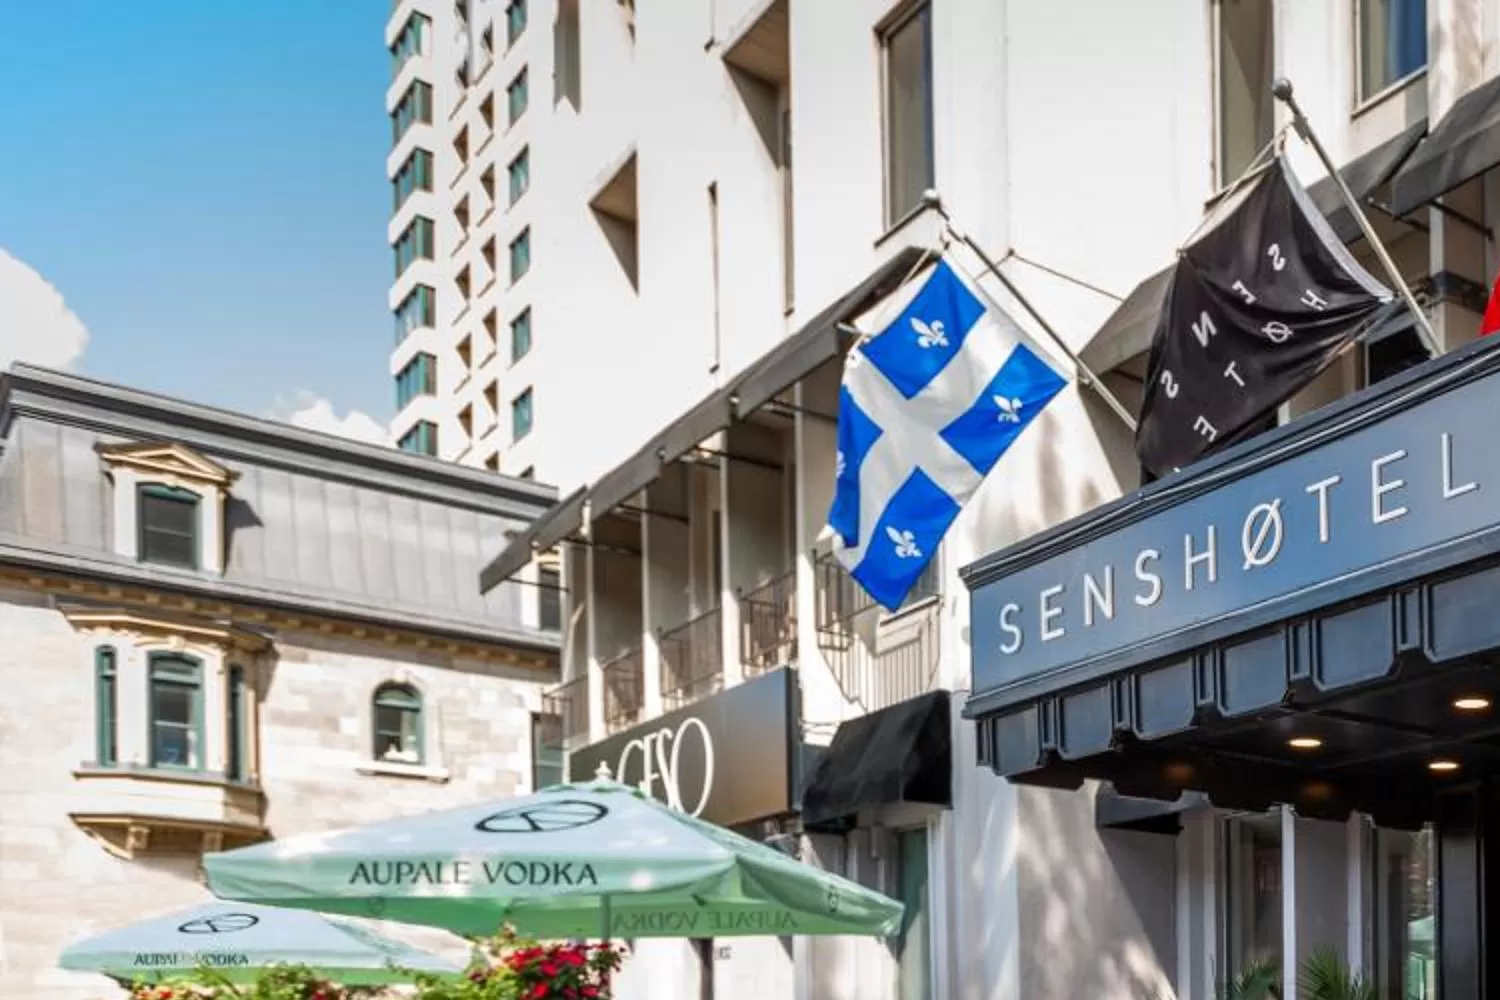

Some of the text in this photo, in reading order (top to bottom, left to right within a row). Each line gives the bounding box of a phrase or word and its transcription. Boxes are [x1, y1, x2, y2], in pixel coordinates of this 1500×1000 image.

[1000, 432, 1479, 655] SENSHØTEL
[349, 861, 597, 885] AUPALE VODKA
